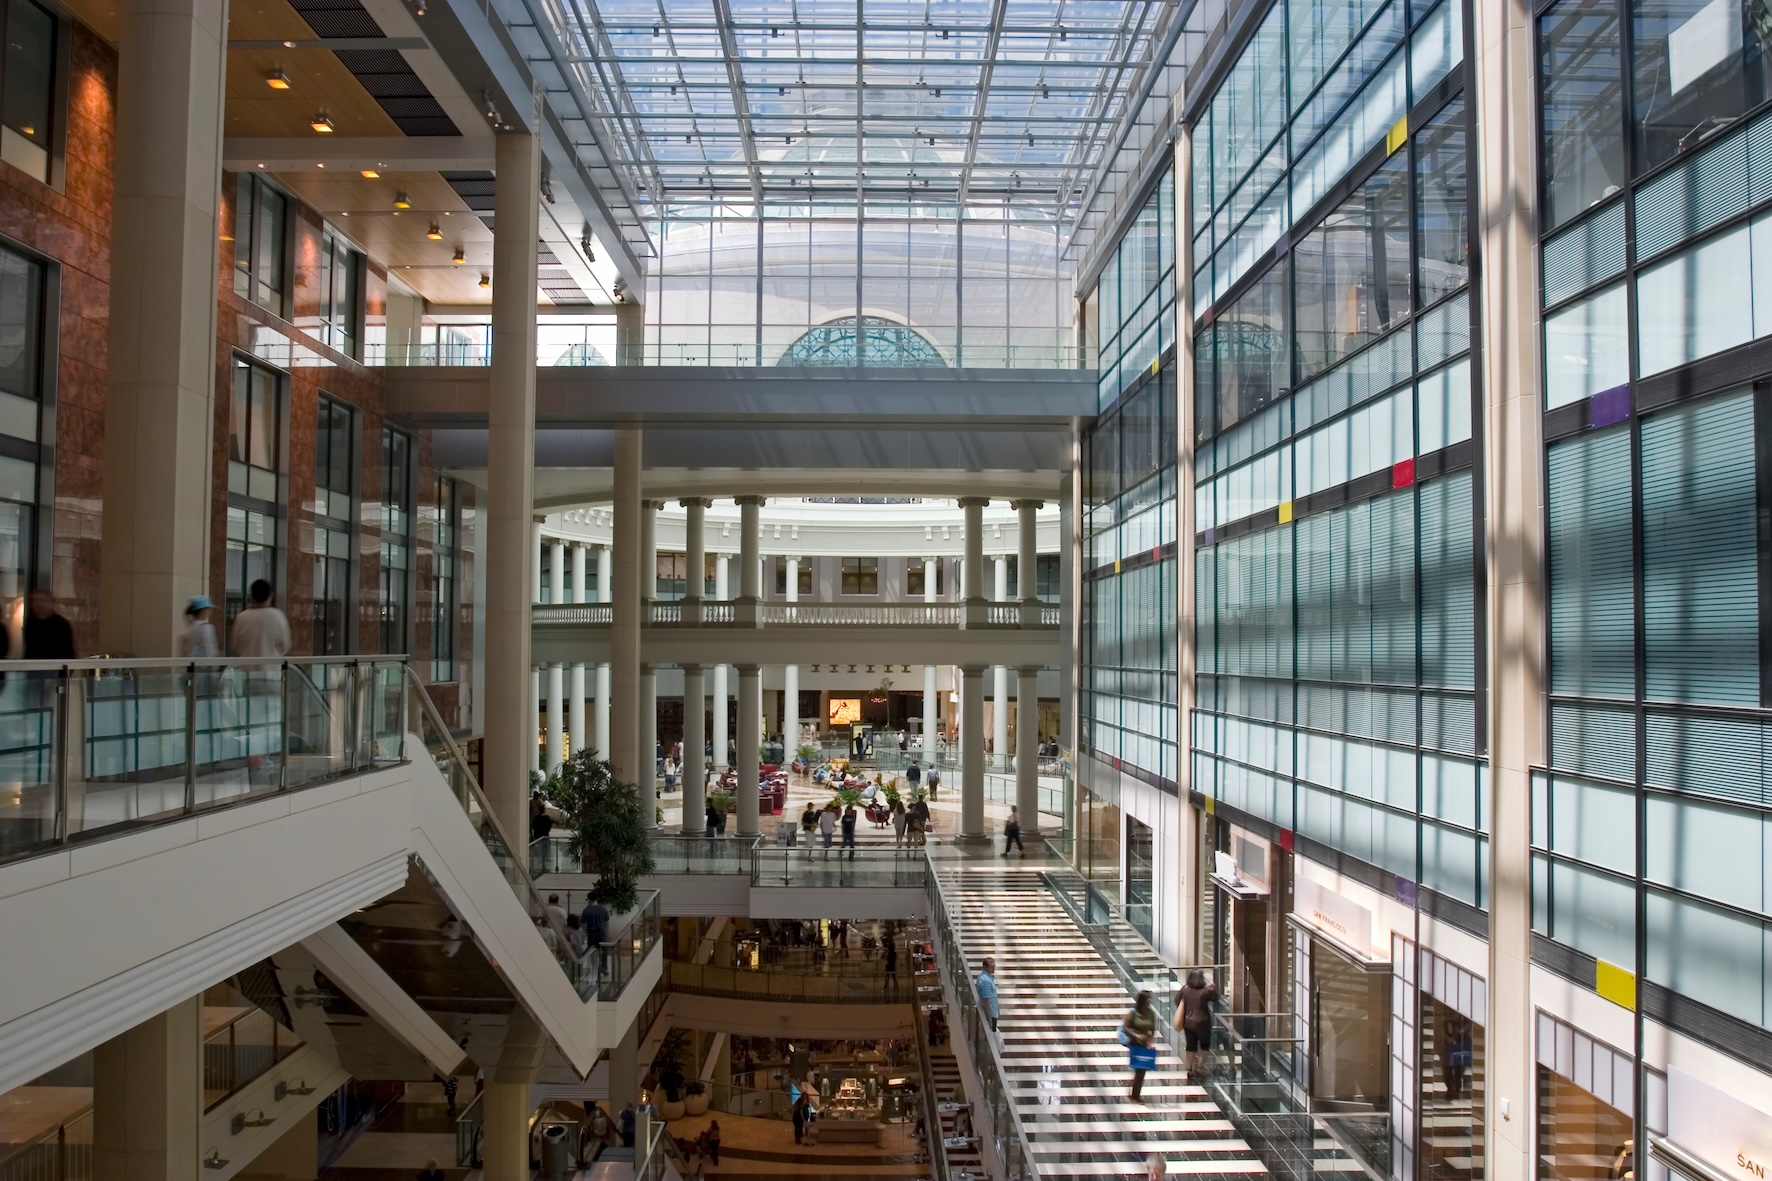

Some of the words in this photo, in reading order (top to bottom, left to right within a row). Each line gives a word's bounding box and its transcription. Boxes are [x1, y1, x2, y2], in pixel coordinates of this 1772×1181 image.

[1313, 910, 1322, 920] SAN
[1322, 914, 1346, 934] FRANCISCO
[1737, 1154, 1765, 1179] SAN
